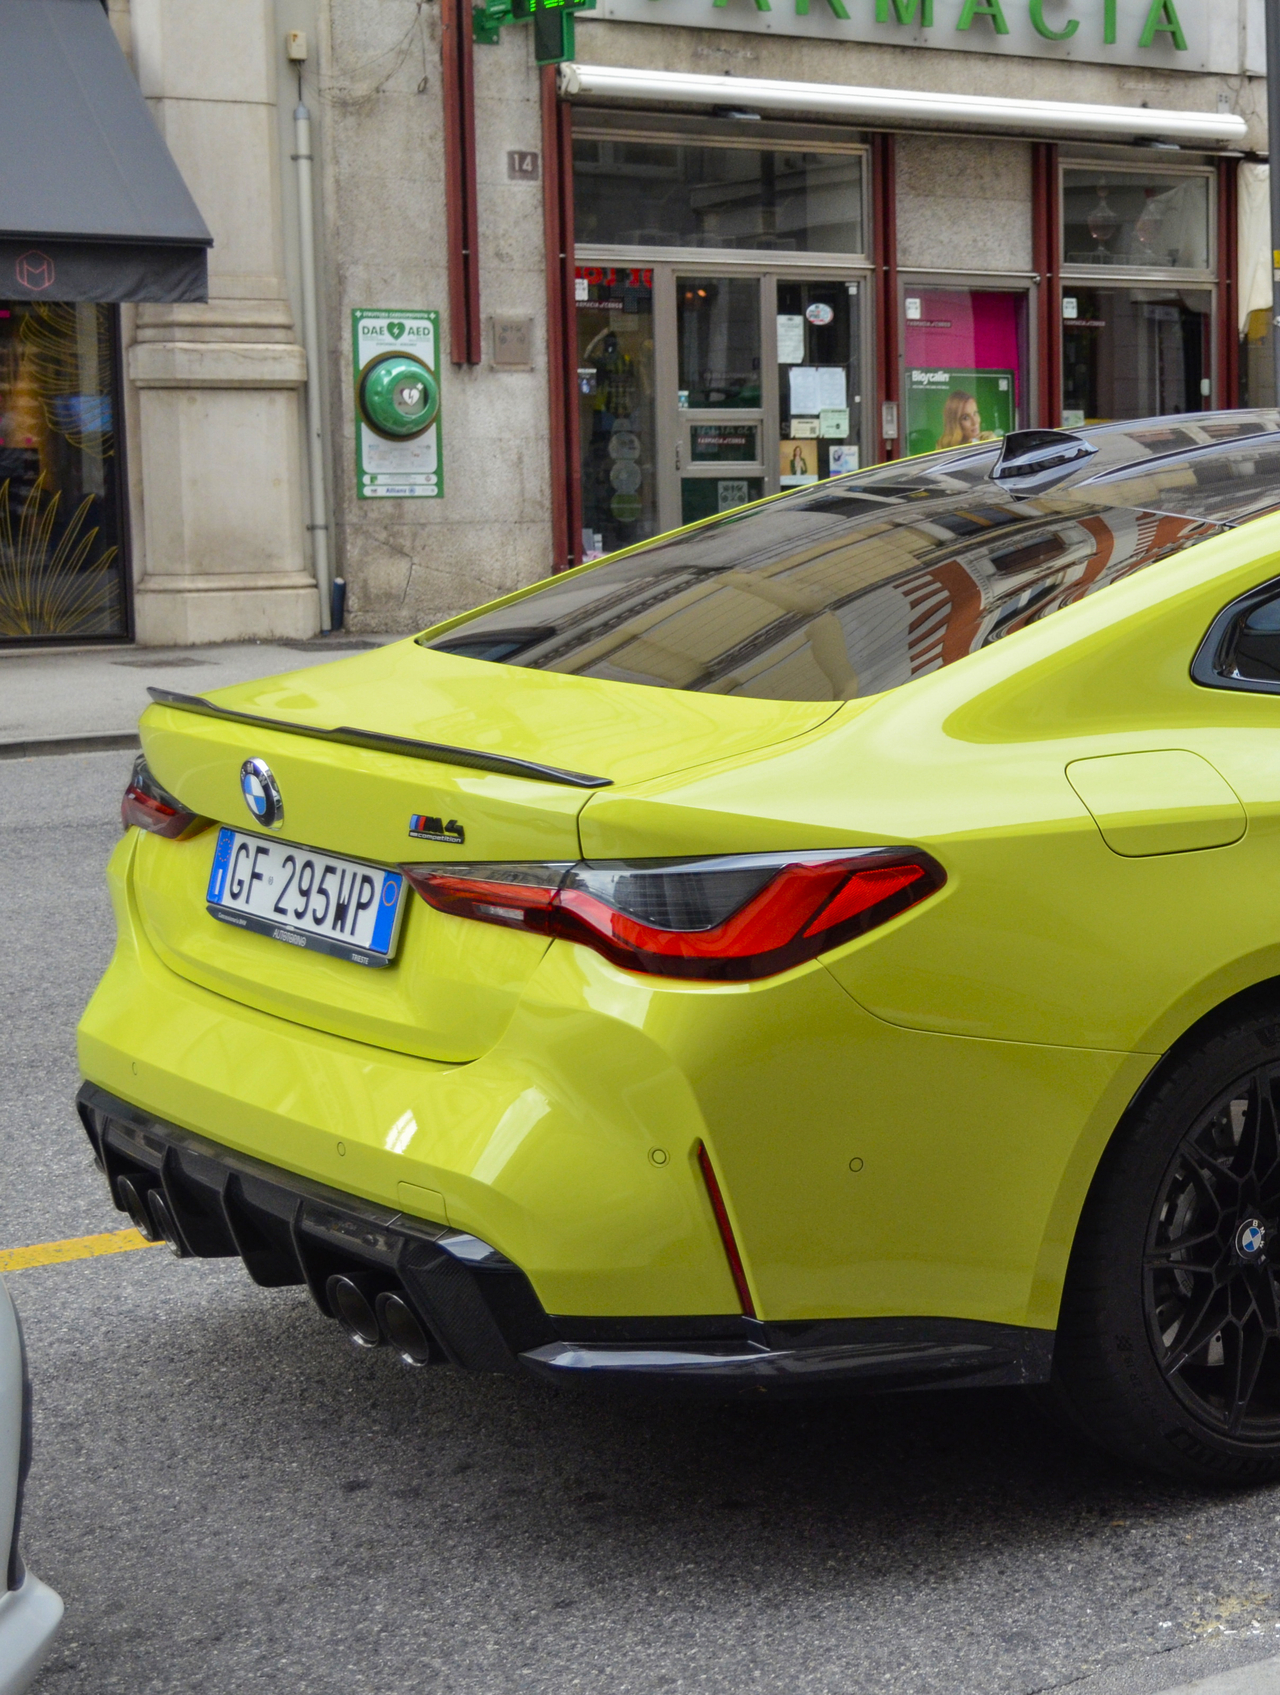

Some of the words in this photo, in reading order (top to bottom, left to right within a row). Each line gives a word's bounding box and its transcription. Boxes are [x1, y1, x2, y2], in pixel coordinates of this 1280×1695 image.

[647, 0, 1187, 51] ACIA
[513, 154, 533, 172] 14
[361, 326, 385, 336] DAE
[407, 326, 431, 337] AED
[418, 833, 462, 844] competition
[229, 842, 270, 905] GF
[273, 854, 375, 936] 295WP
[272, 928, 307, 947] AUTOTORINO
[351, 953, 370, 965] TRIESTE
